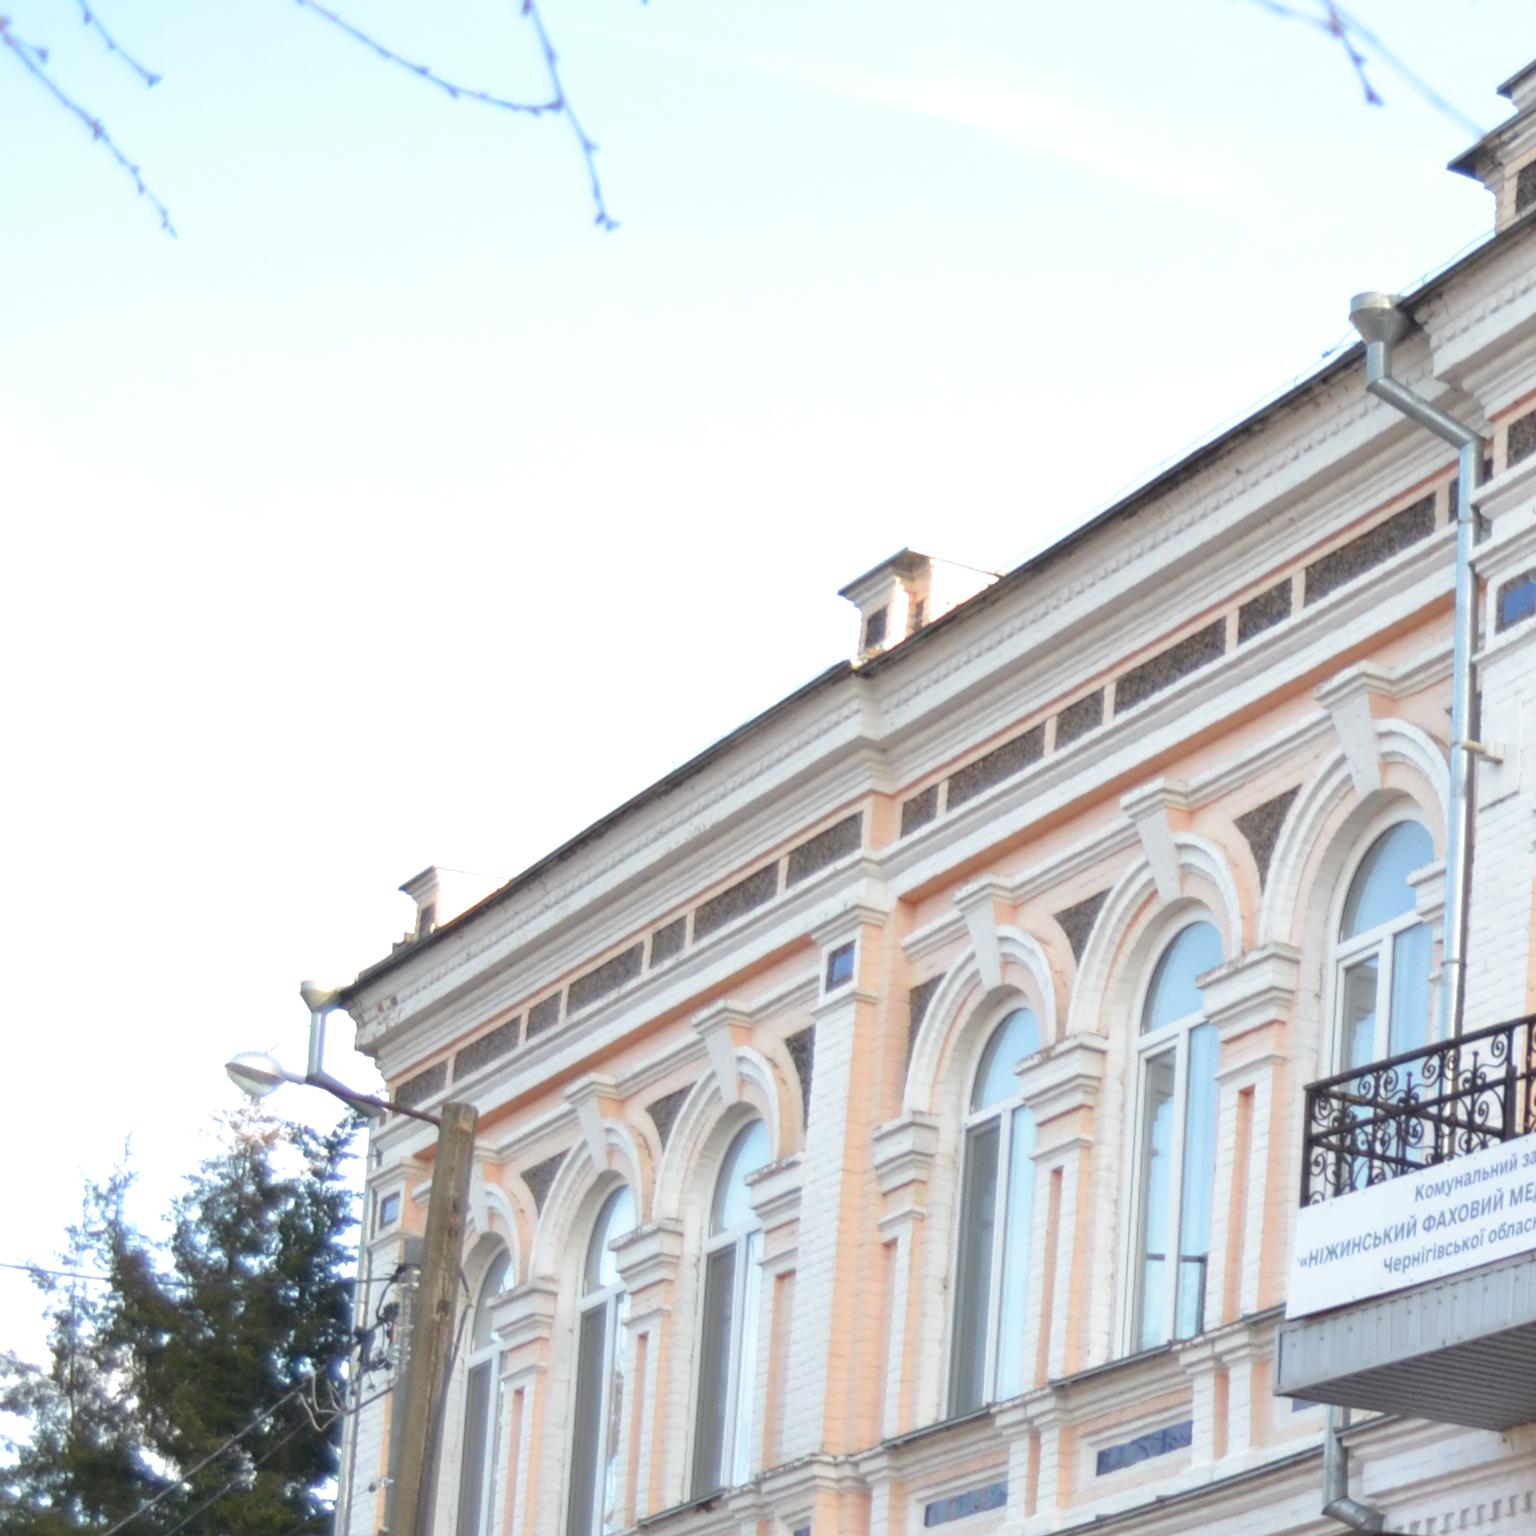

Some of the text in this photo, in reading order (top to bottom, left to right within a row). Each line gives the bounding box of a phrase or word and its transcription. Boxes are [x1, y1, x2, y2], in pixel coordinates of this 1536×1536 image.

[1414, 1153, 1518, 1202] Комунальний
[1299, 1215, 1417, 1269] «НІЖИНСЬКИЙ
[1422, 1188, 1504, 1233] ФАХОВИЙ
[1383, 1227, 1486, 1273] Чернігівської
